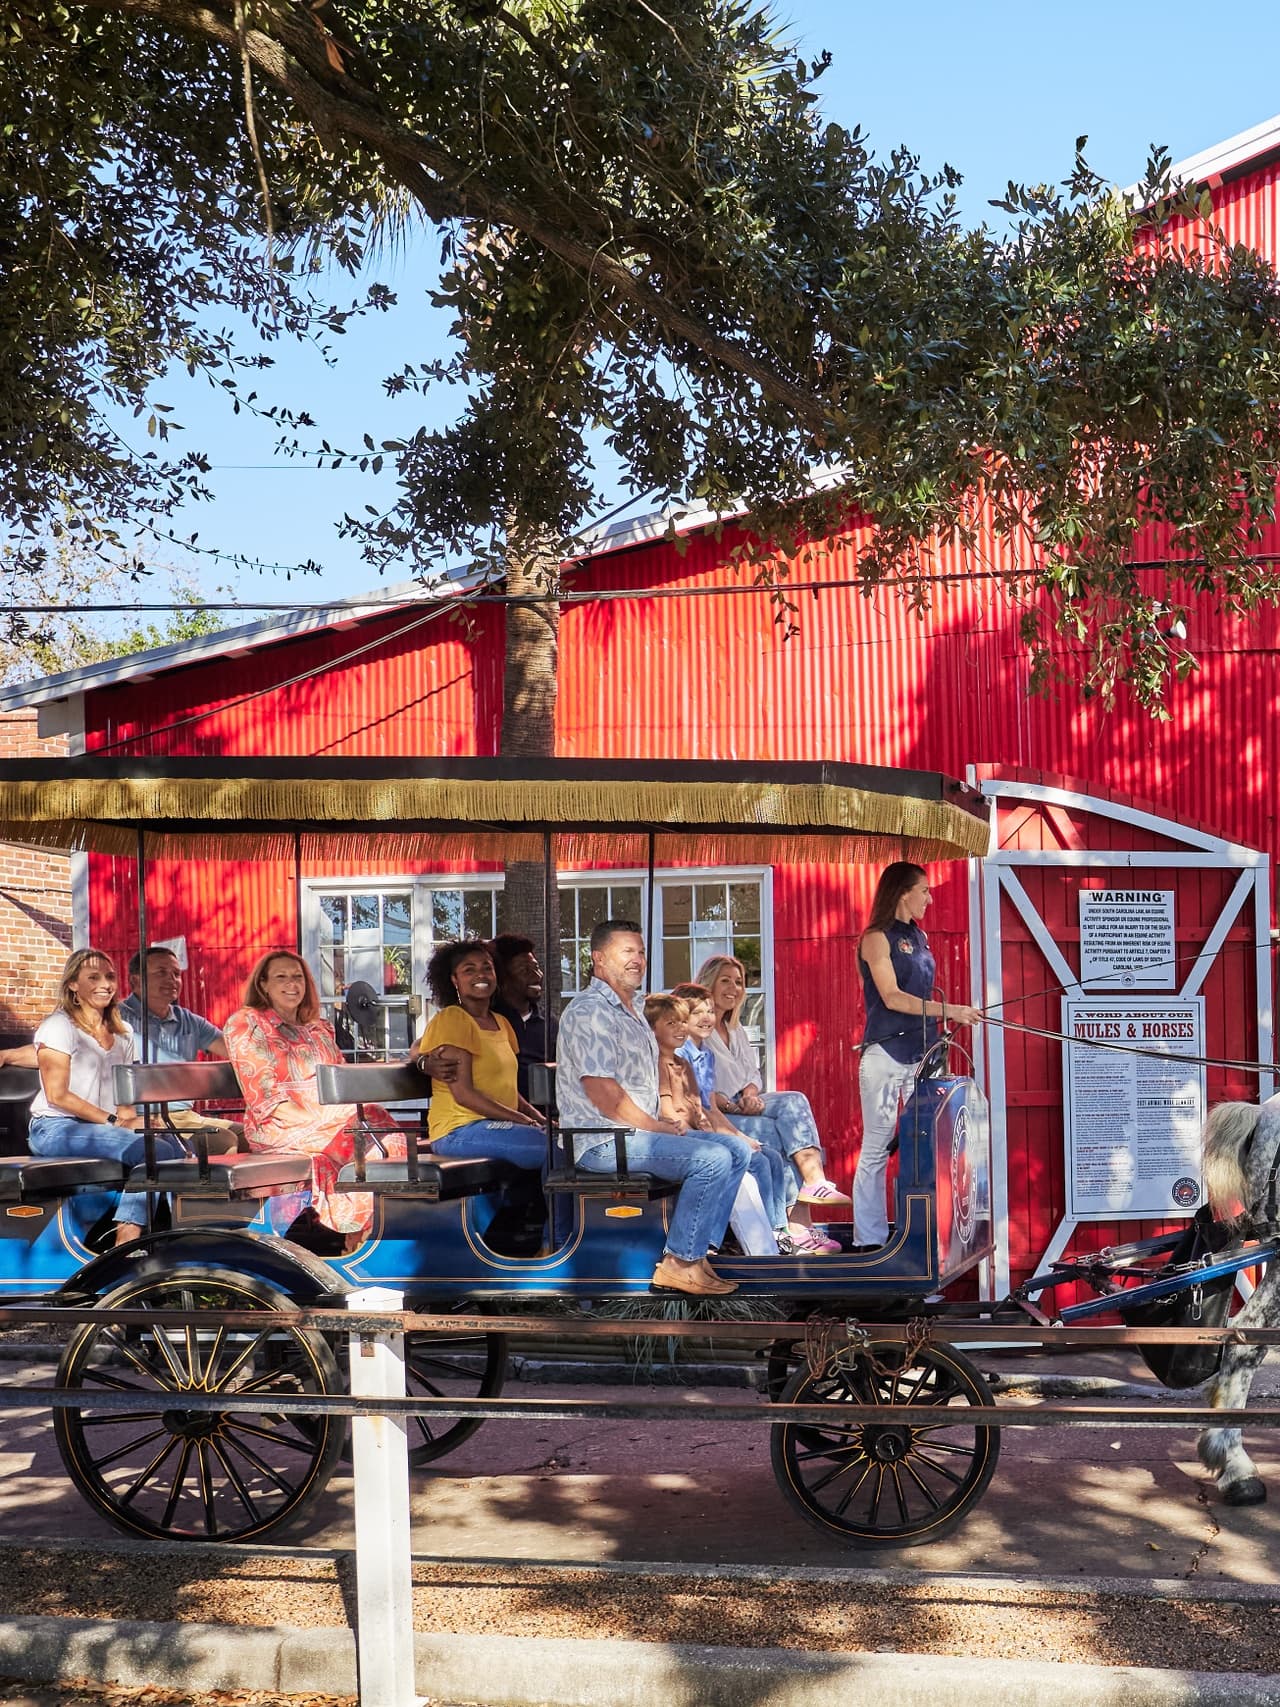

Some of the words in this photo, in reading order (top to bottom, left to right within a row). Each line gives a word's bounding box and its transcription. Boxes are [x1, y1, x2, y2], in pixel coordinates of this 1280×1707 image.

[1092, 892, 1162, 902] WARNING
[1074, 1023, 1121, 1038] MULES
[1127, 1023, 1136, 1038] &
[1142, 1023, 1194, 1038] HORSES
